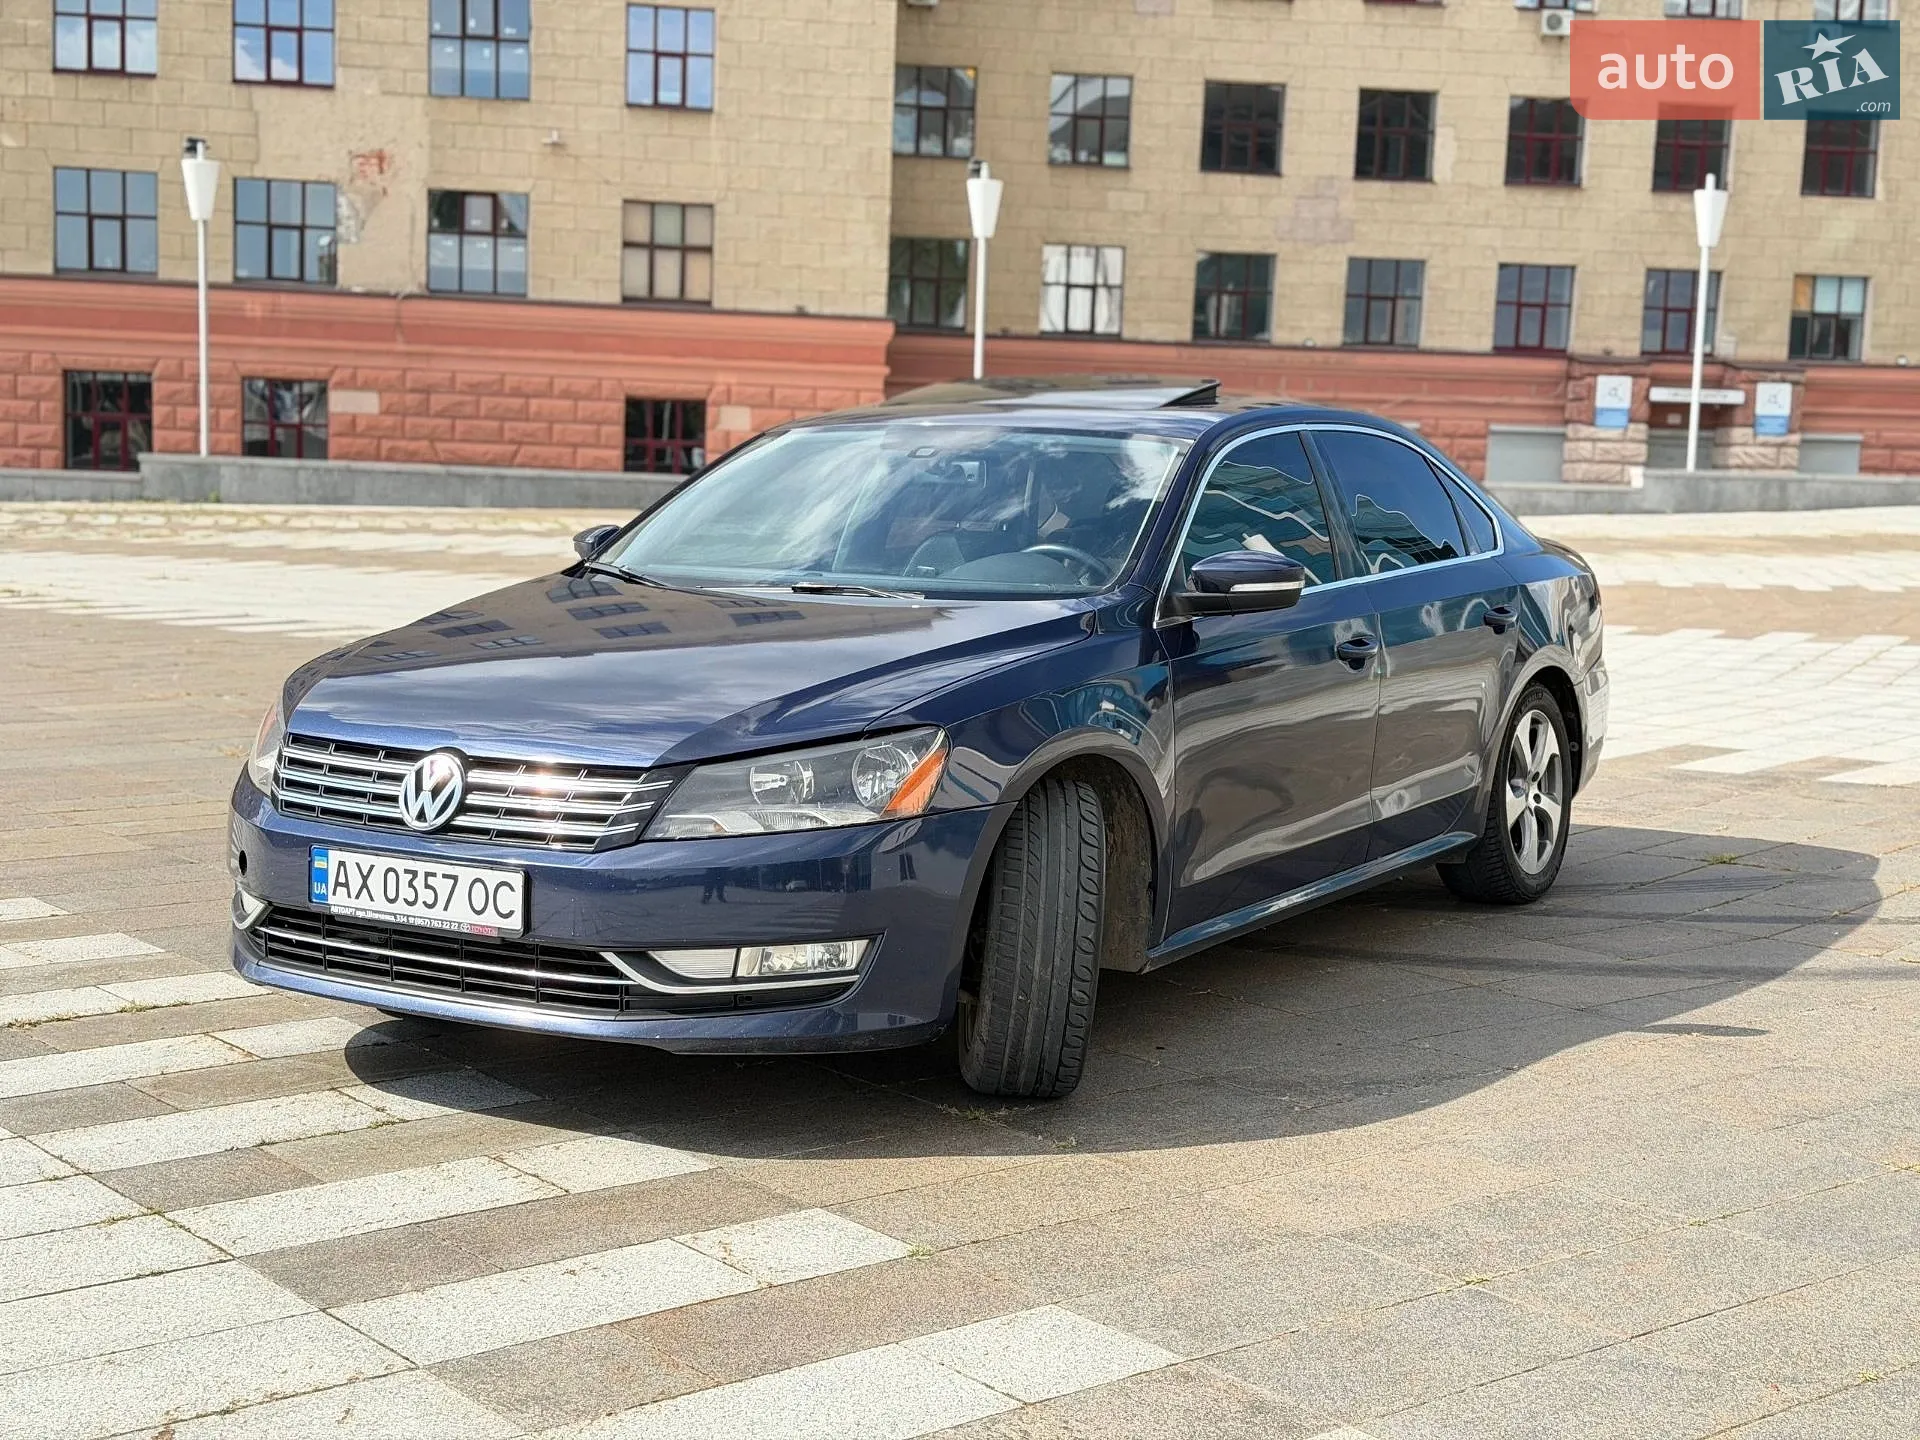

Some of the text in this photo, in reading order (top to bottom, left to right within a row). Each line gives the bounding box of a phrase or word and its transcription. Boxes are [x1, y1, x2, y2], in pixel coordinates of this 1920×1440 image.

[314, 884, 327, 895] UA
[332, 860, 516, 919] AX 0357 OC
